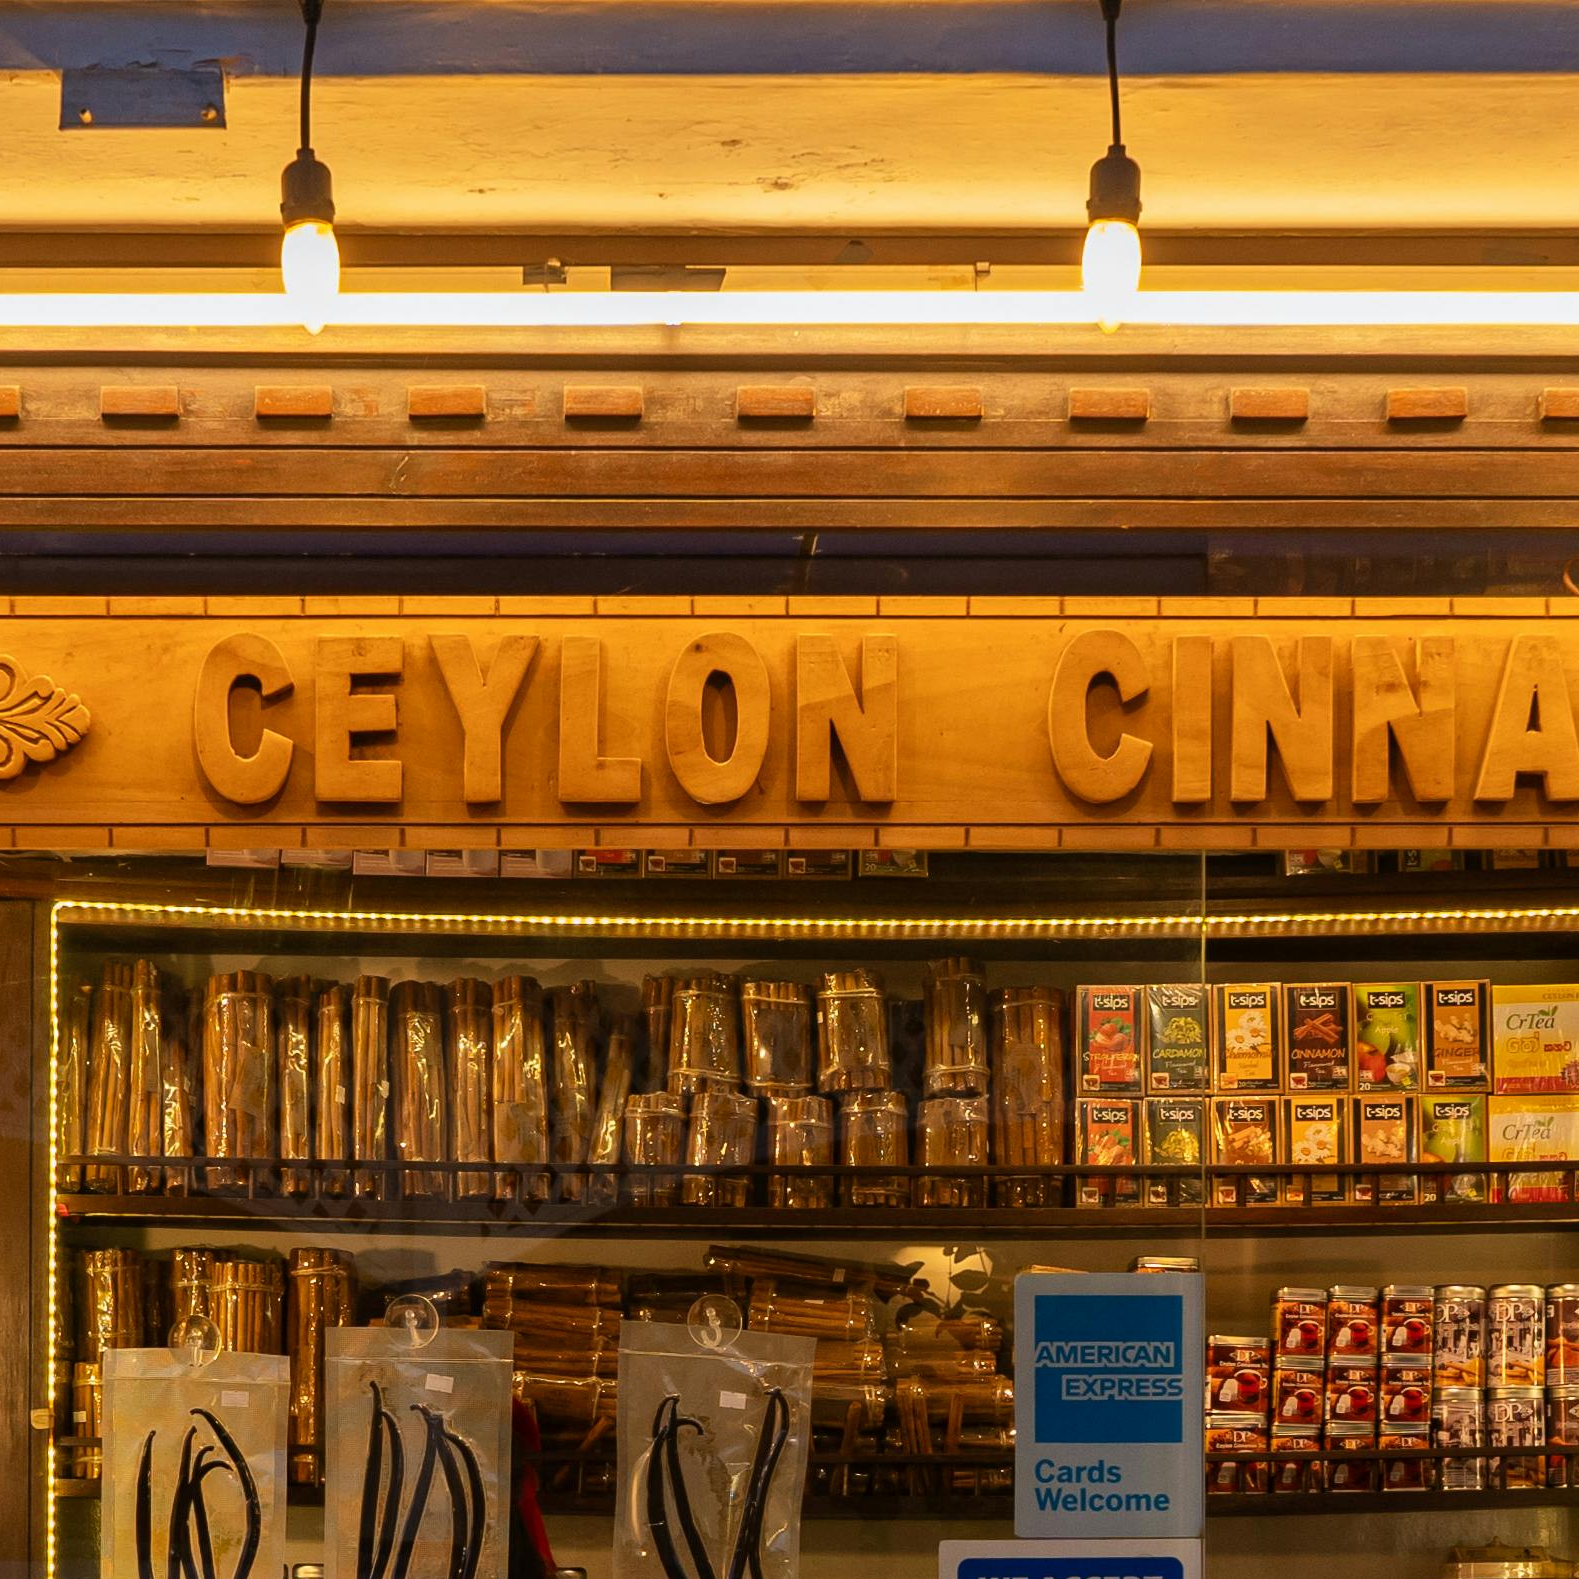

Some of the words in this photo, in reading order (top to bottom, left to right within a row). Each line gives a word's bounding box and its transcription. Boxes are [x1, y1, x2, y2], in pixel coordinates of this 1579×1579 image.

[194, 630, 898, 804] CEYLON
[1094, 995, 1129, 1009] t-sips
[1162, 994, 1198, 1007] t-sips
[1230, 993, 1265, 1007] t-sips
[1299, 993, 1335, 1007] t-sips
[1369, 992, 1404, 1006] t-sips
[1438, 991, 1473, 1004] t-sips
[1506, 1012, 1556, 1029] CrTea
[1374, 1027, 1399, 1035] Apple
[1291, 1048, 1345, 1059] CINNAMON
[1433, 1047, 1479, 1058] GINGER
[1358, 1082, 1371, 1091] 20
[1093, 1107, 1127, 1121] t-sips
[1160, 1107, 1195, 1120] t-sips
[1229, 1106, 1263, 1120] t-sips
[1297, 1106, 1331, 1120] t-sips
[1366, 1104, 1401, 1118] t-sips
[1435, 1104, 1470, 1118] t-sips
[1502, 1124, 1551, 1140] CrTea
[1495, 1303, 1523, 1322] DP
[1035, 1343, 1173, 1366] AMERICAN
[1064, 1376, 1184, 1397] EXPRESS
[1494, 1403, 1522, 1423] DP
[1034, 1457, 1122, 1484] Cards
[1035, 1487, 1170, 1513] Welcome
